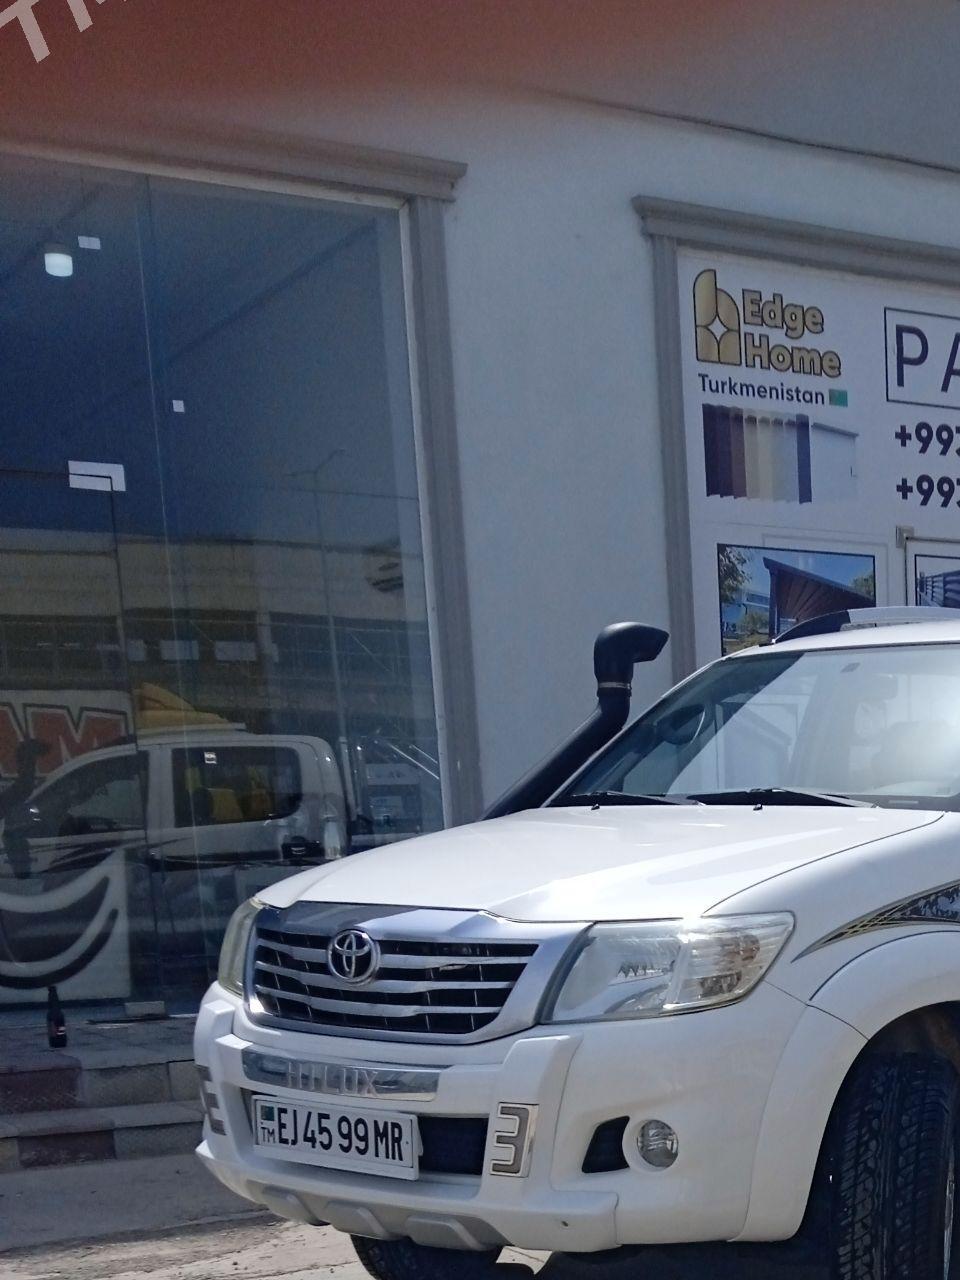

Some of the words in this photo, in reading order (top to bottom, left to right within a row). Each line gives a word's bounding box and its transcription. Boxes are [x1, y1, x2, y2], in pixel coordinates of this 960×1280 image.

[742, 288, 824, 339] Edge
[744, 332, 842, 378] Home
[698, 373, 826, 405] Turkmenistan
[286, 1061, 379, 1098] HILUX
[260, 1126, 276, 1144] TM
